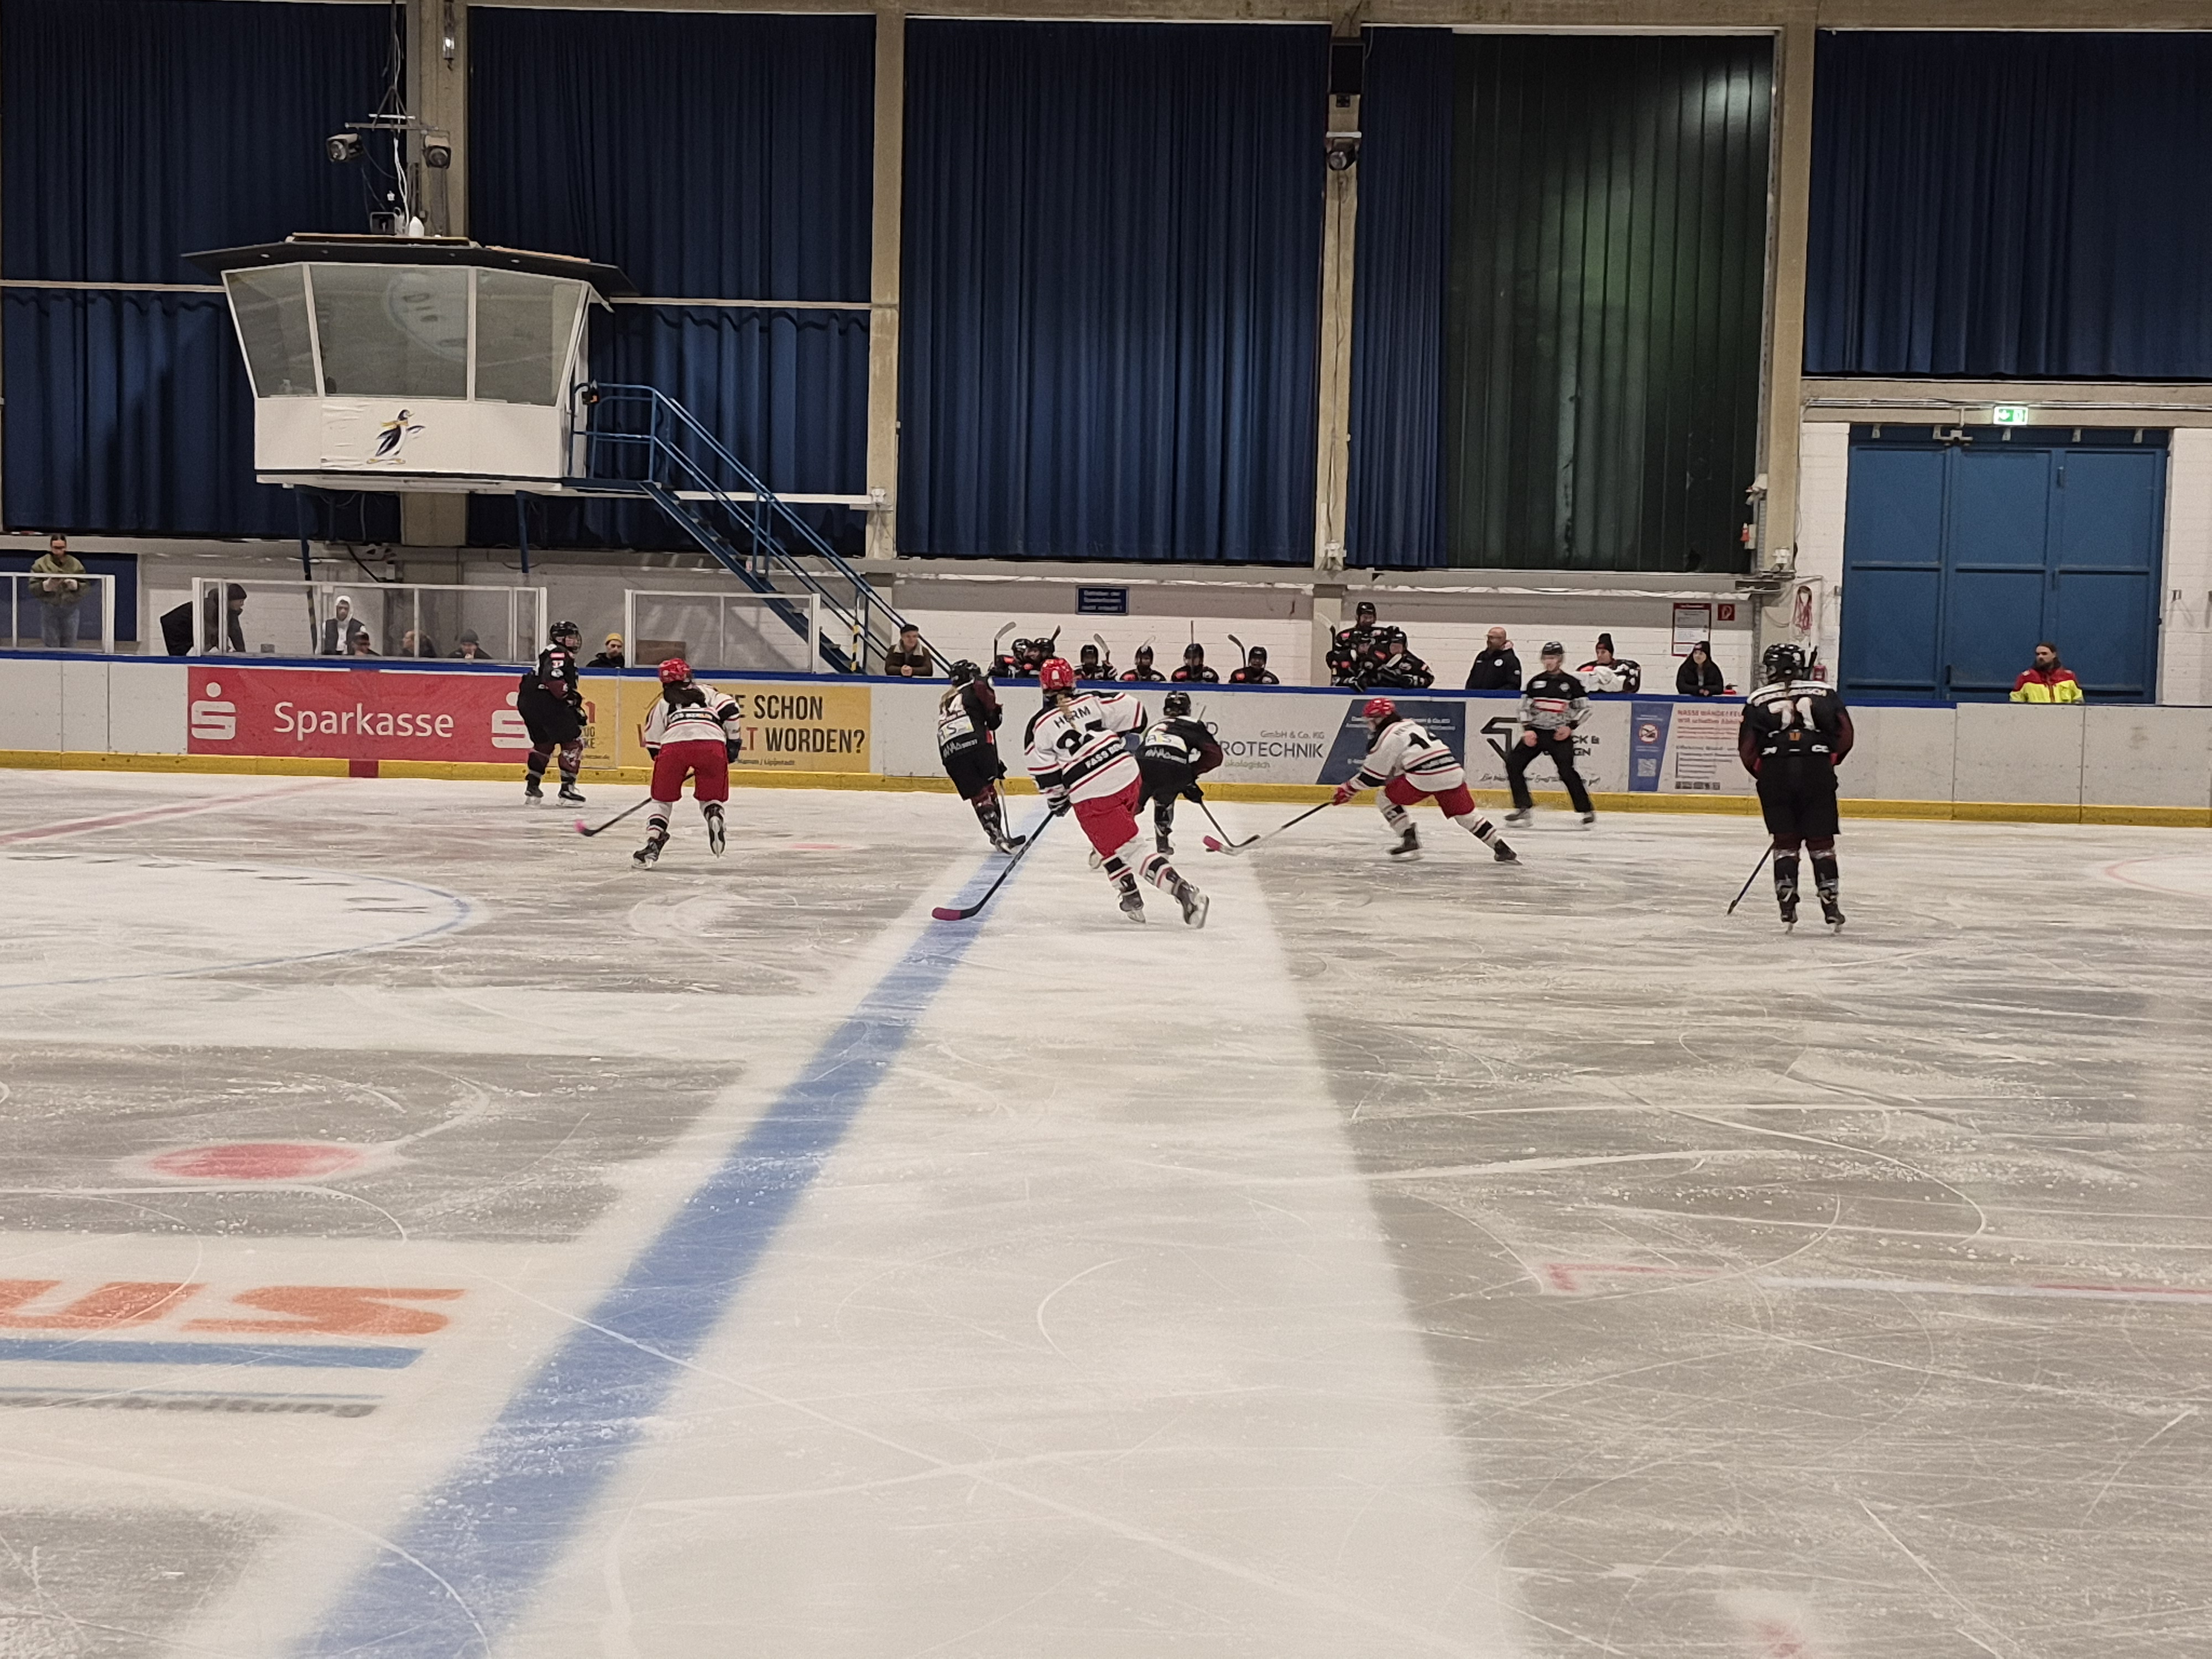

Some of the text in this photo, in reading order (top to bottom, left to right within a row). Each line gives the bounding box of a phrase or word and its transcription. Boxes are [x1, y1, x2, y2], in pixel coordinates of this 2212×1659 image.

[754, 695, 822, 720] SCHON
[274, 702, 453, 740] Sparkasse
[765, 727, 865, 753] WORDEN?
